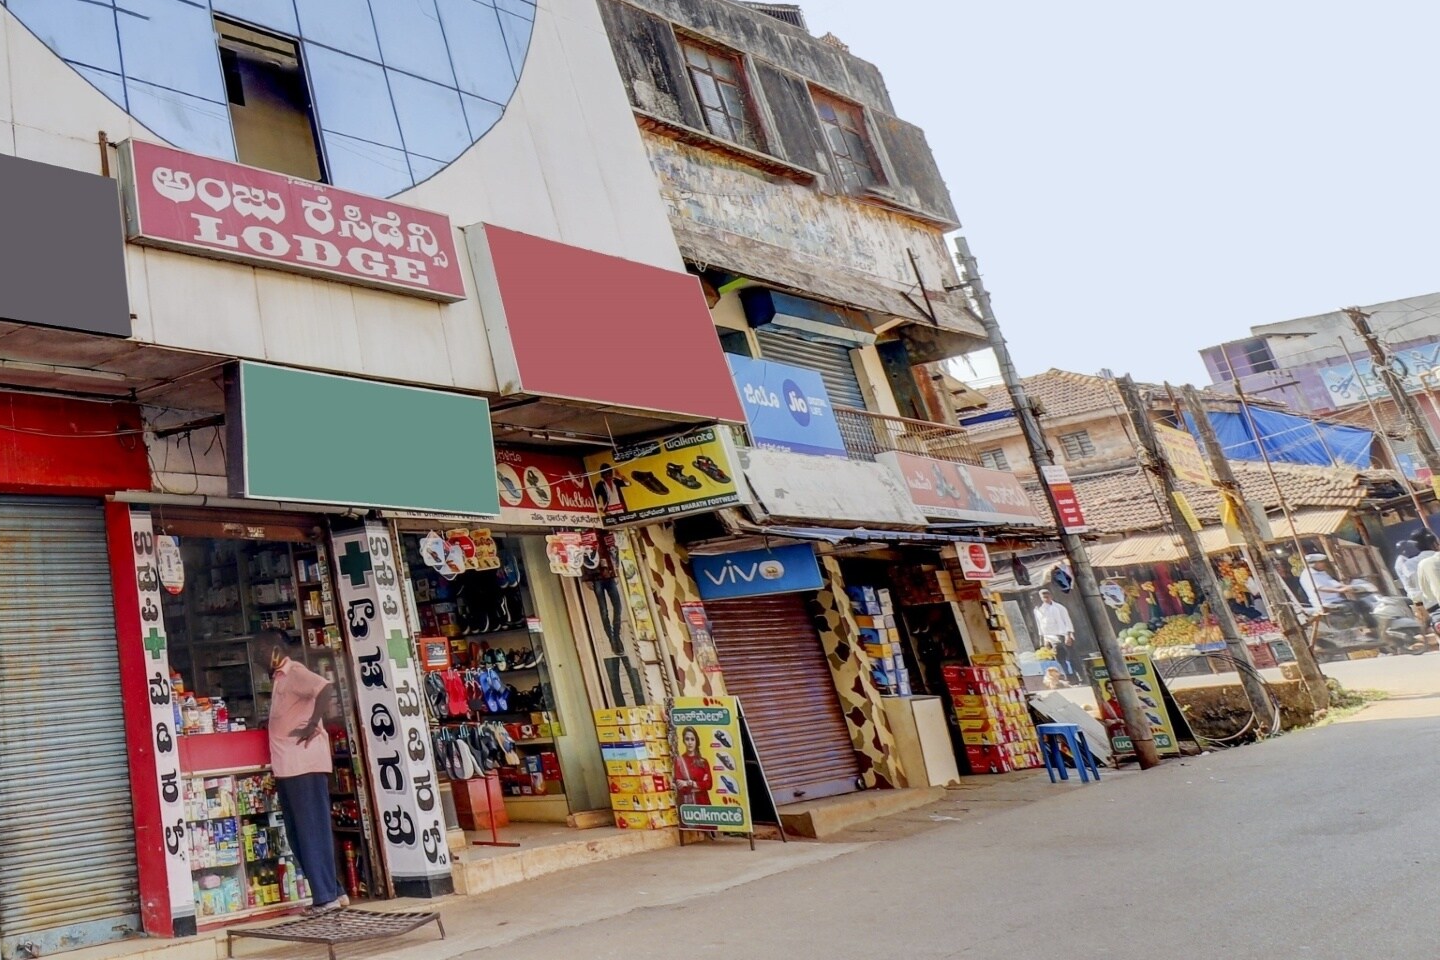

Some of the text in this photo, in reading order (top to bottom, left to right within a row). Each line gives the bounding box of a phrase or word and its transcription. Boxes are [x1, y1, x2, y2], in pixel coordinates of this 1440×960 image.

[151, 166, 286, 225] ಅಂಜು
[190, 212, 430, 286] LODGE
[665, 431, 714, 450] walkmate
[668, 505, 681, 514] NEW
[681, 500, 707, 511] BHARATH
[704, 559, 785, 585] vivo
[683, 807, 743, 822] walkmate
